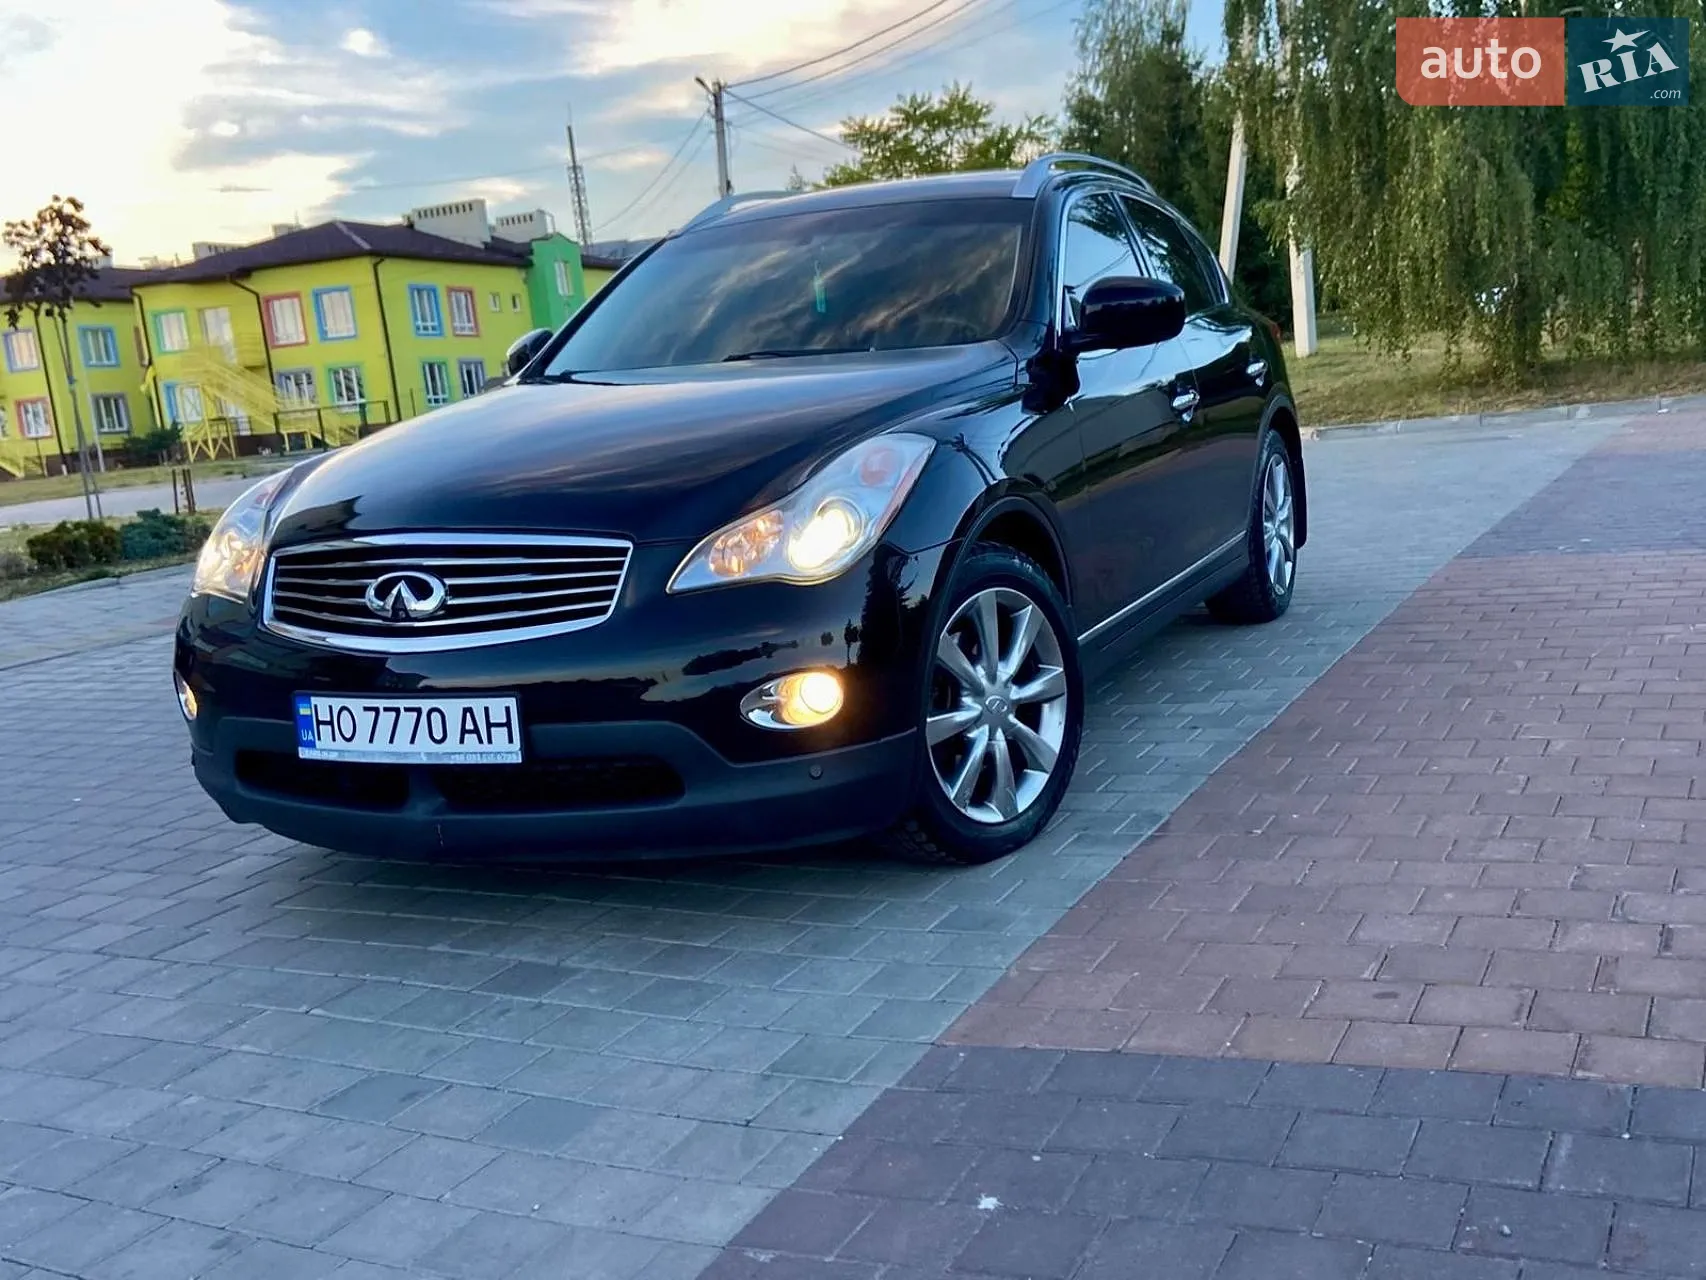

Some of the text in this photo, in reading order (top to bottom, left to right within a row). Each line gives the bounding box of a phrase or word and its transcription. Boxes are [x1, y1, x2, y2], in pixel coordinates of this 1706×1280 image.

[301, 730, 314, 741] UA
[313, 703, 514, 745] HO 7770 AH
